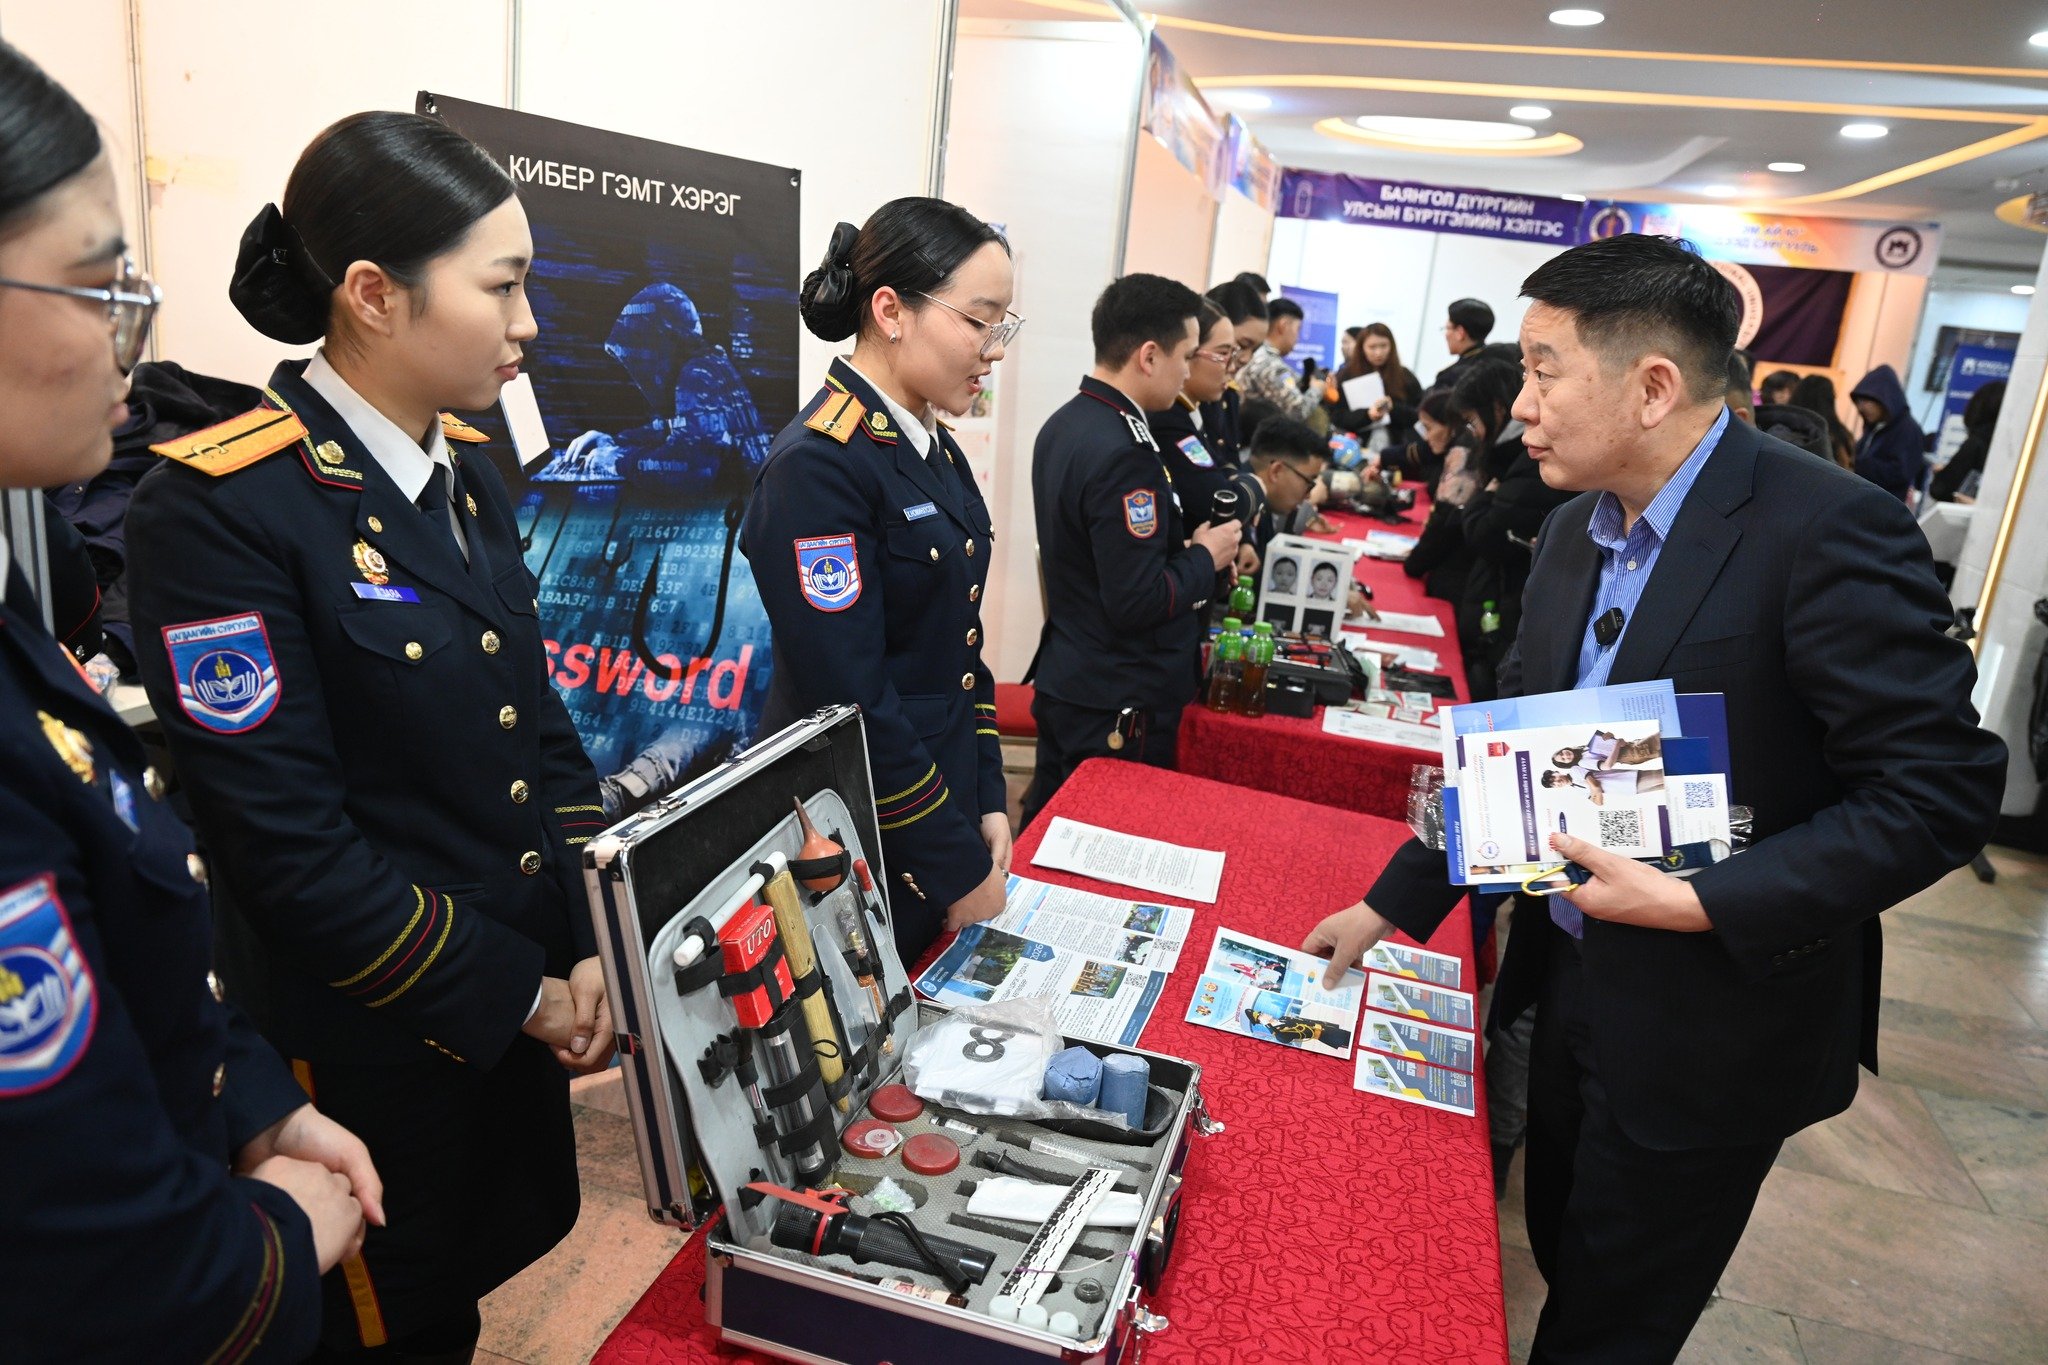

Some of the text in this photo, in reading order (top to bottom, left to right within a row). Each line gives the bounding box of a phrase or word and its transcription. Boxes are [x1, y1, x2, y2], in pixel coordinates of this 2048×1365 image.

[509, 154, 741, 216] КИБЕР ГЭМТ ХЭРЭГ
[1380, 185, 1454, 204] БАЯНГОЛ
[1343, 201, 1400, 221] УЛСЫН
[1504, 218, 1564, 238] ХЭЛТЭС
[747, 919, 771, 955] UTO
